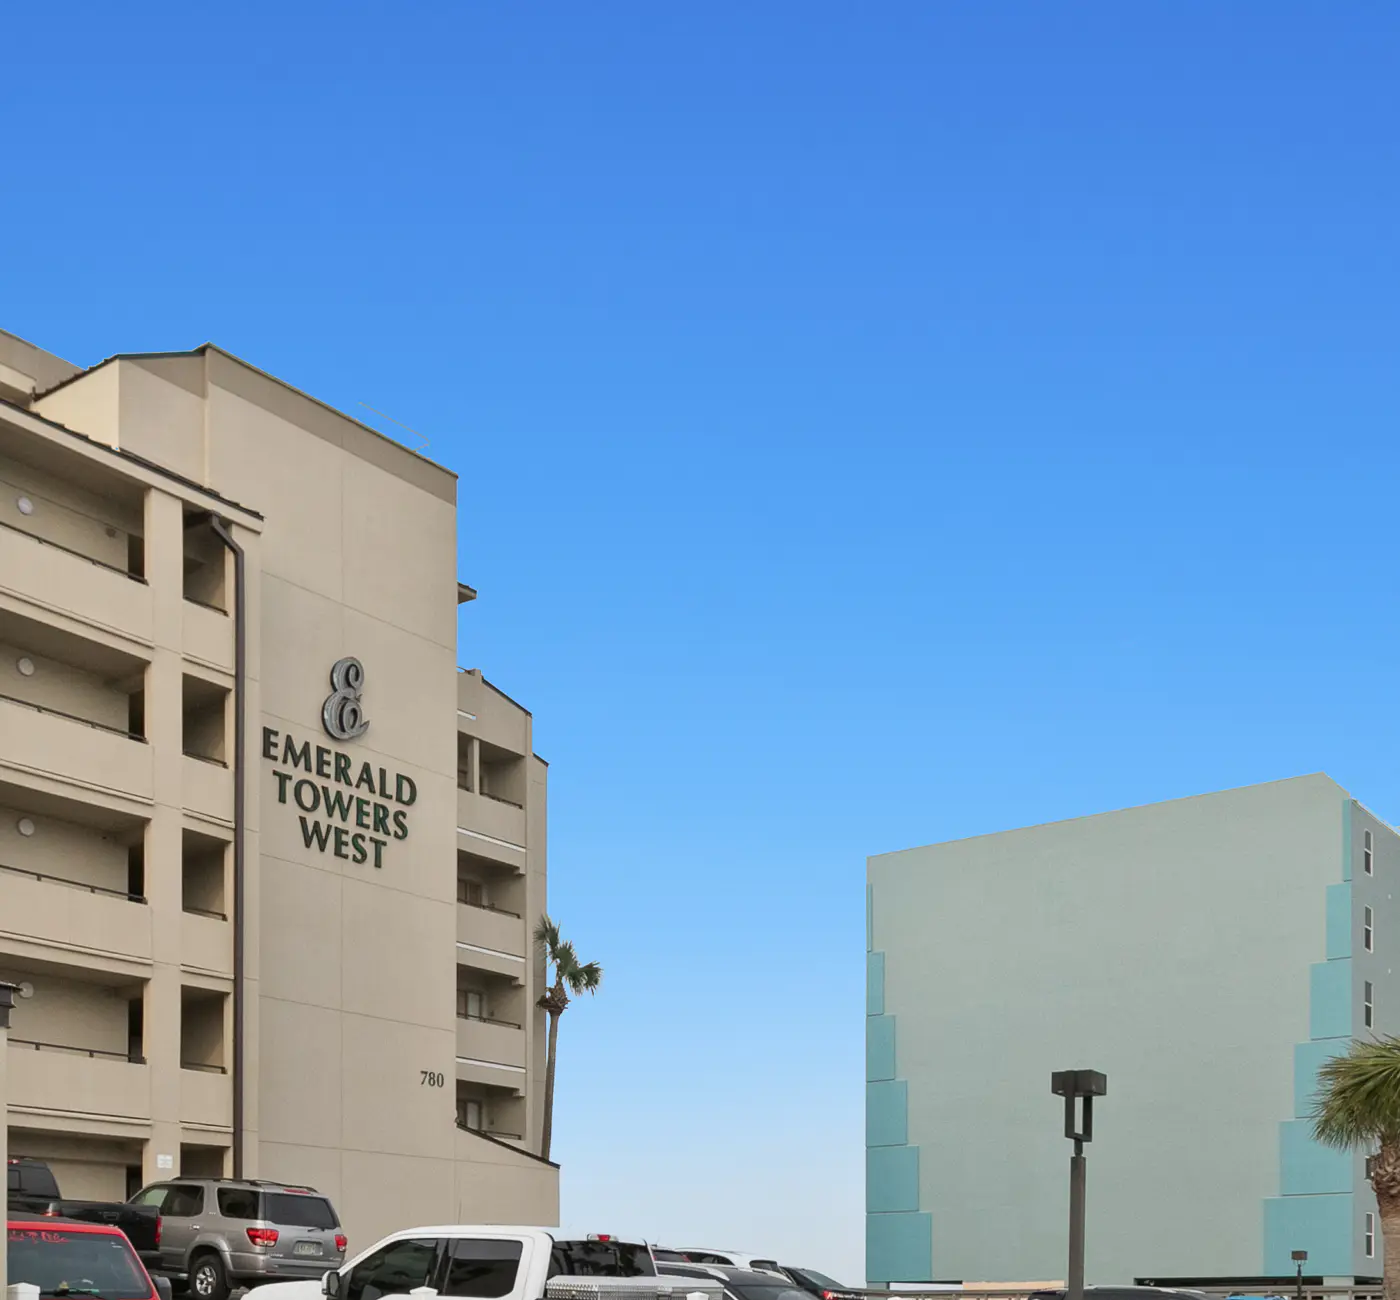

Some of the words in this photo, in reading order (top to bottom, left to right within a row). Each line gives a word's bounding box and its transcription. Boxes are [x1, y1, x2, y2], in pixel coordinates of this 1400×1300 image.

[262, 726, 417, 806] EMERALD
[272, 769, 409, 840] TOWERS
[298, 815, 387, 869] WEST
[419, 1070, 445, 1088] 780
